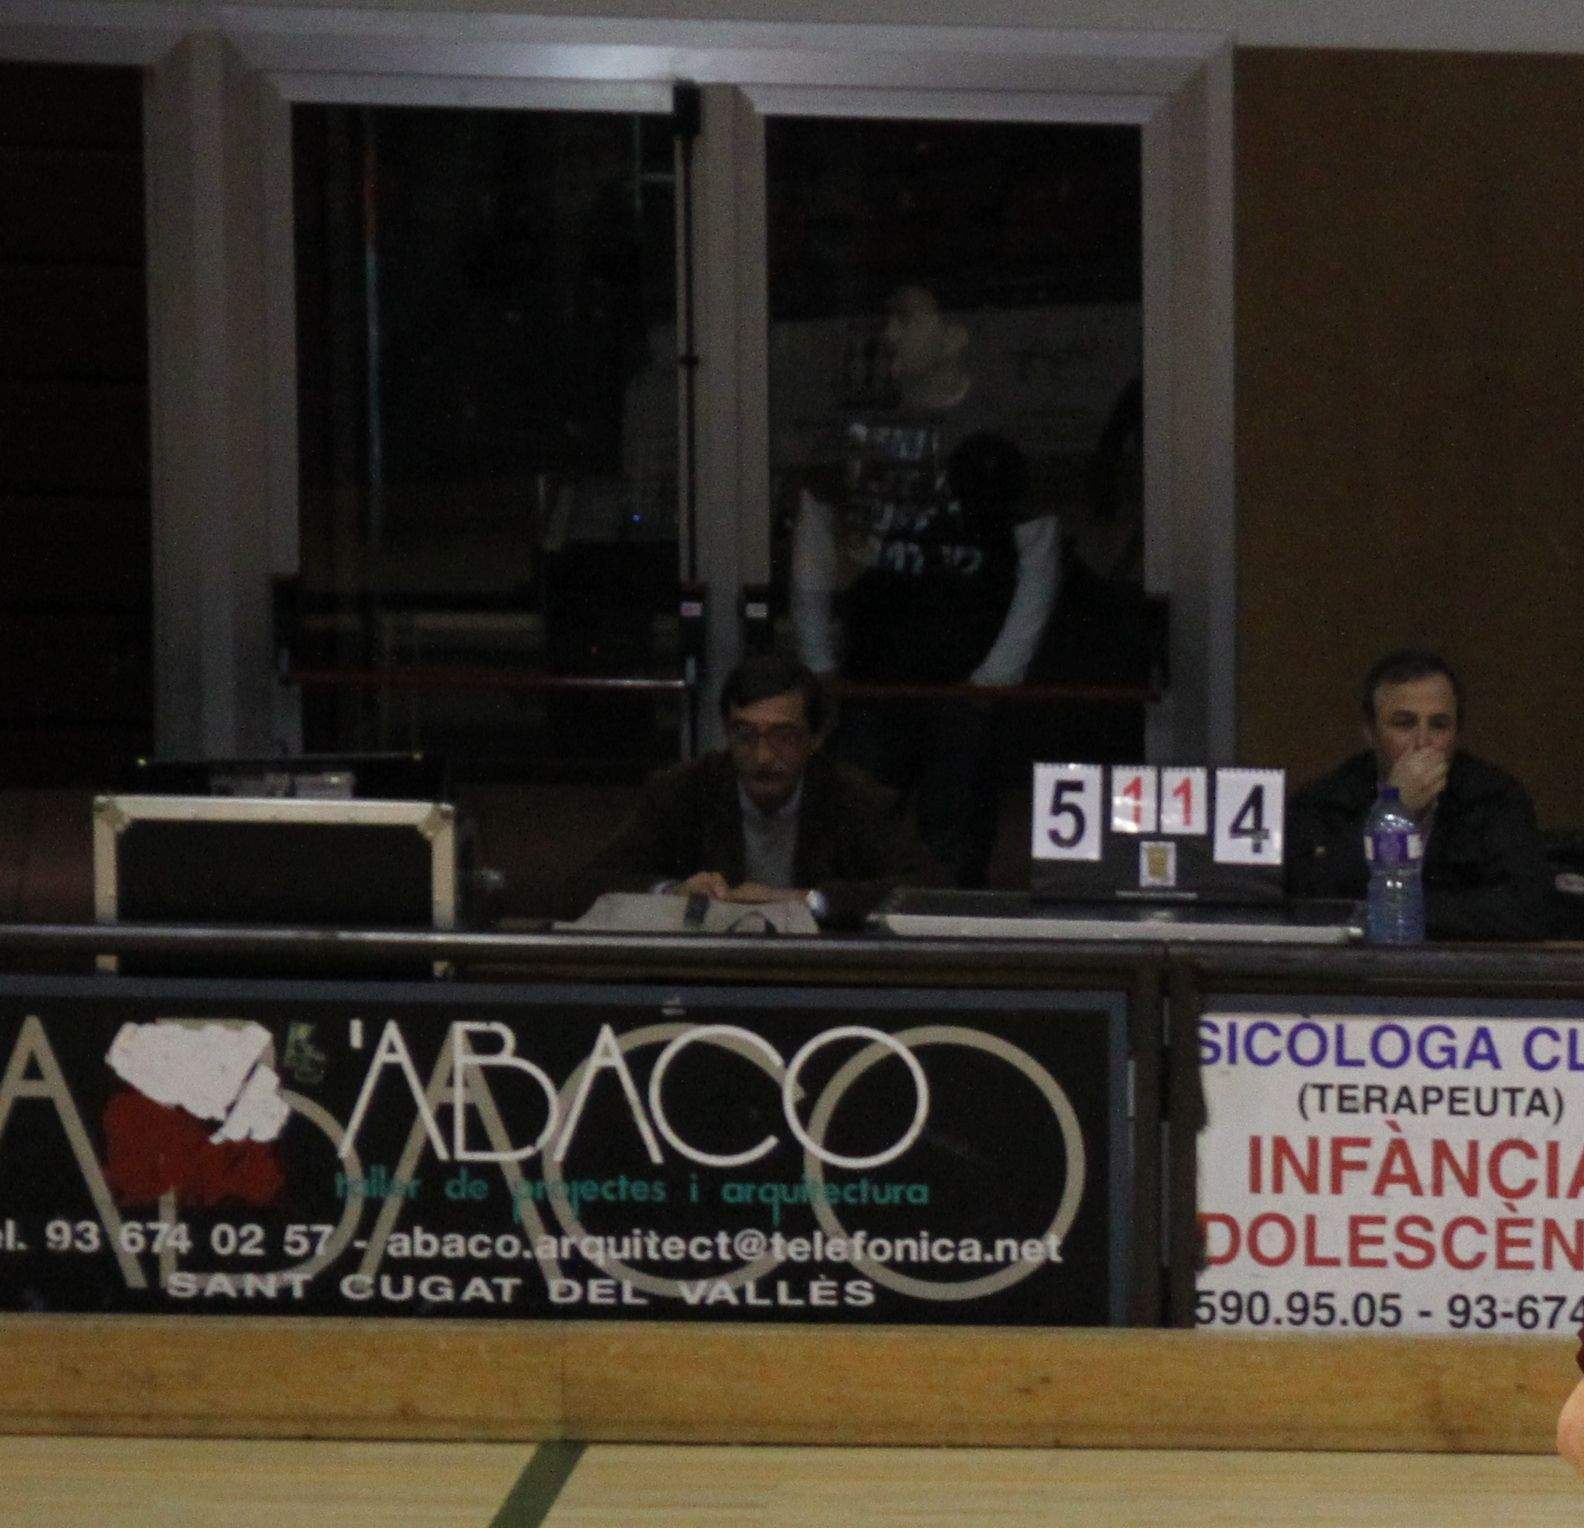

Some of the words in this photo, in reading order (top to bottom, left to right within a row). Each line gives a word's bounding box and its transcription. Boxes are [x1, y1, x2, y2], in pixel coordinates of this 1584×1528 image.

[1047, 779, 1086, 848] 5
[1230, 785, 1270, 853] 4
[1298, 1082, 1565, 1125] (TERAPEUTA)
[335, 1170, 421, 1200] taller
[443, 1168, 489, 1201] de
[511, 1172, 667, 1224] projectes
[688, 1172, 700, 1203] i
[720, 1172, 930, 1224] arquitectura
[45, 1219, 101, 1254] 93
[118, 1220, 193, 1255] 674
[210, 1223, 264, 1256] 02
[283, 1224, 334, 1257] 57
[387, 1226, 1064, 1266] abaco.arquitect@telefonica.net
[166, 1271, 314, 1299] SANT
[340, 1272, 521, 1303] CUGAT
[548, 1277, 649, 1305] DEL
[678, 1273, 877, 1307] VALLÈS
